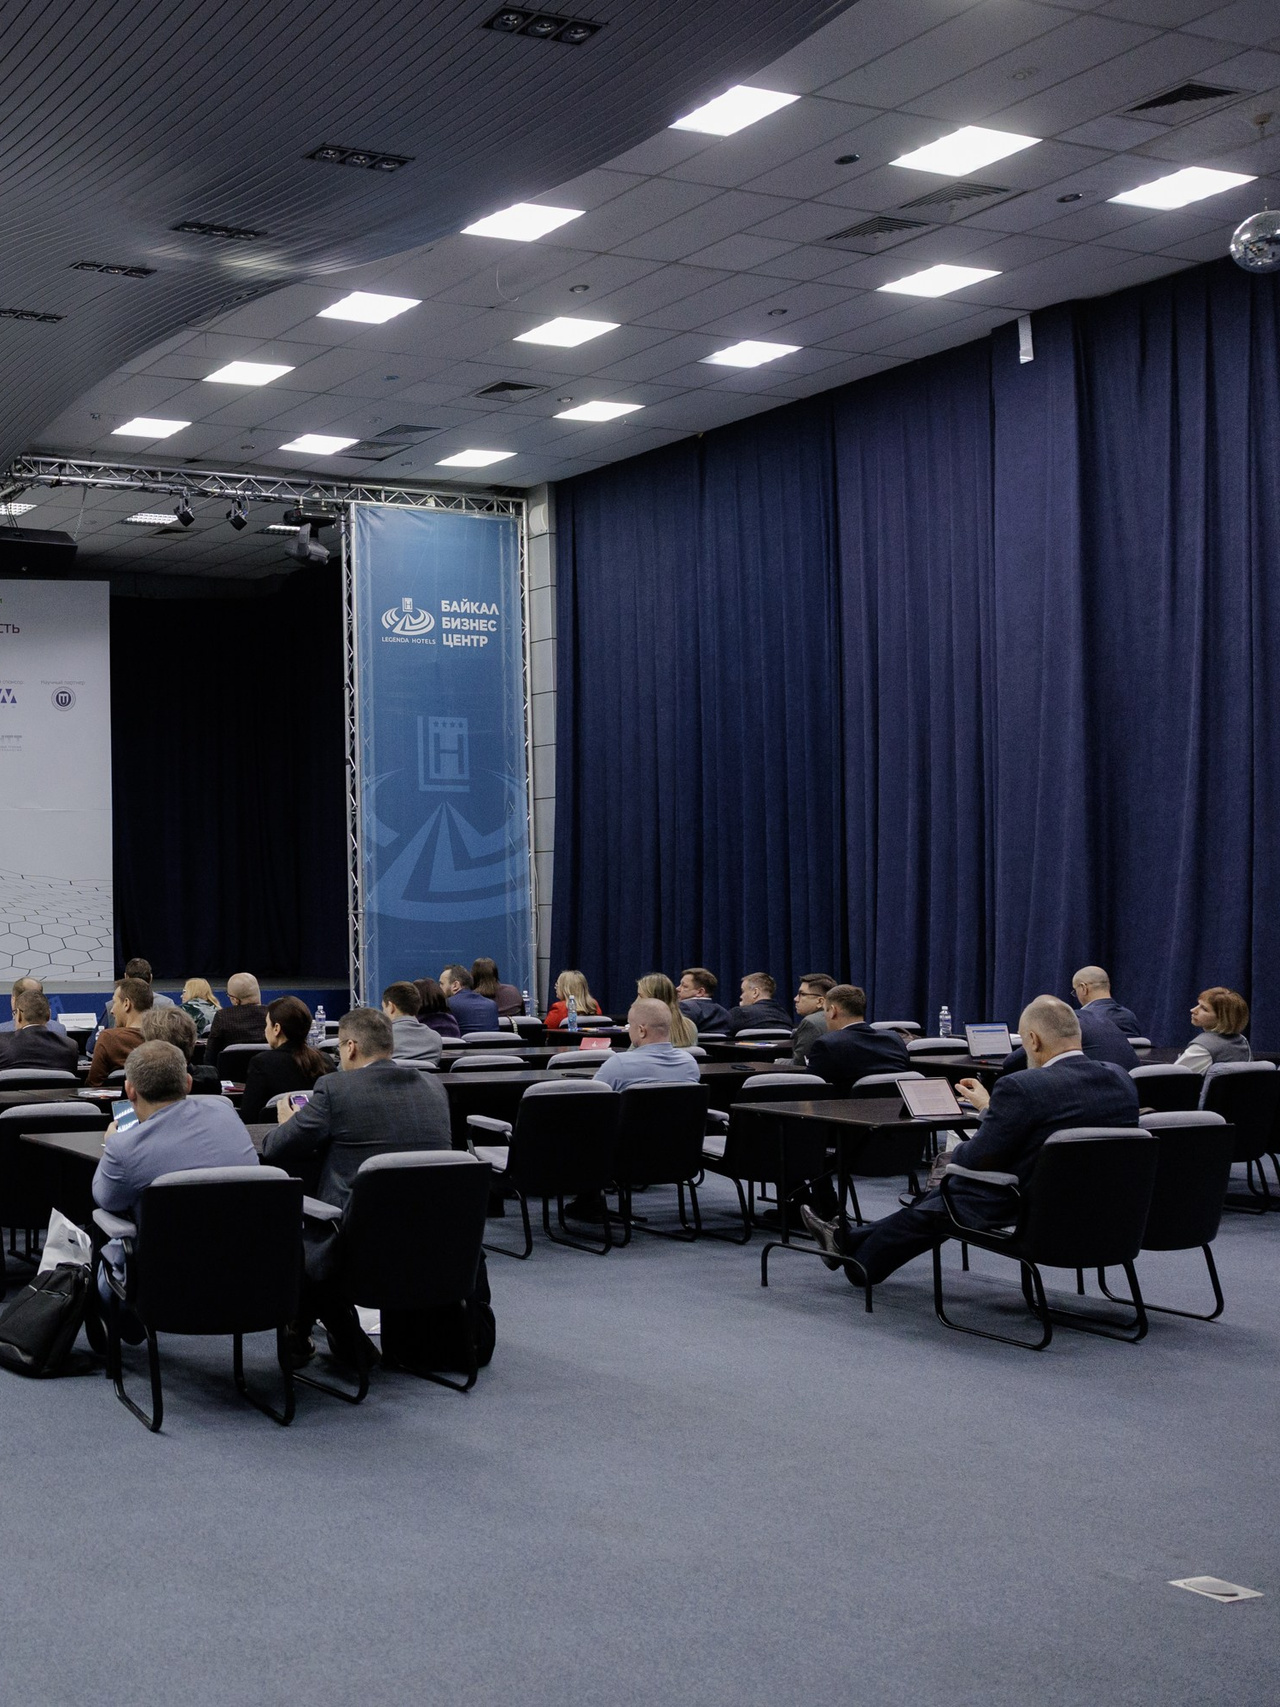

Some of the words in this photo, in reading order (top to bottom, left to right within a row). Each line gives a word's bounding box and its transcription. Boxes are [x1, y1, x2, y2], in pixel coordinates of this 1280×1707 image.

[441, 598, 499, 615] БАЙКАЛ
[442, 617, 497, 632] БИЗНЕС
[442, 634, 488, 648] ЦЕНТР
